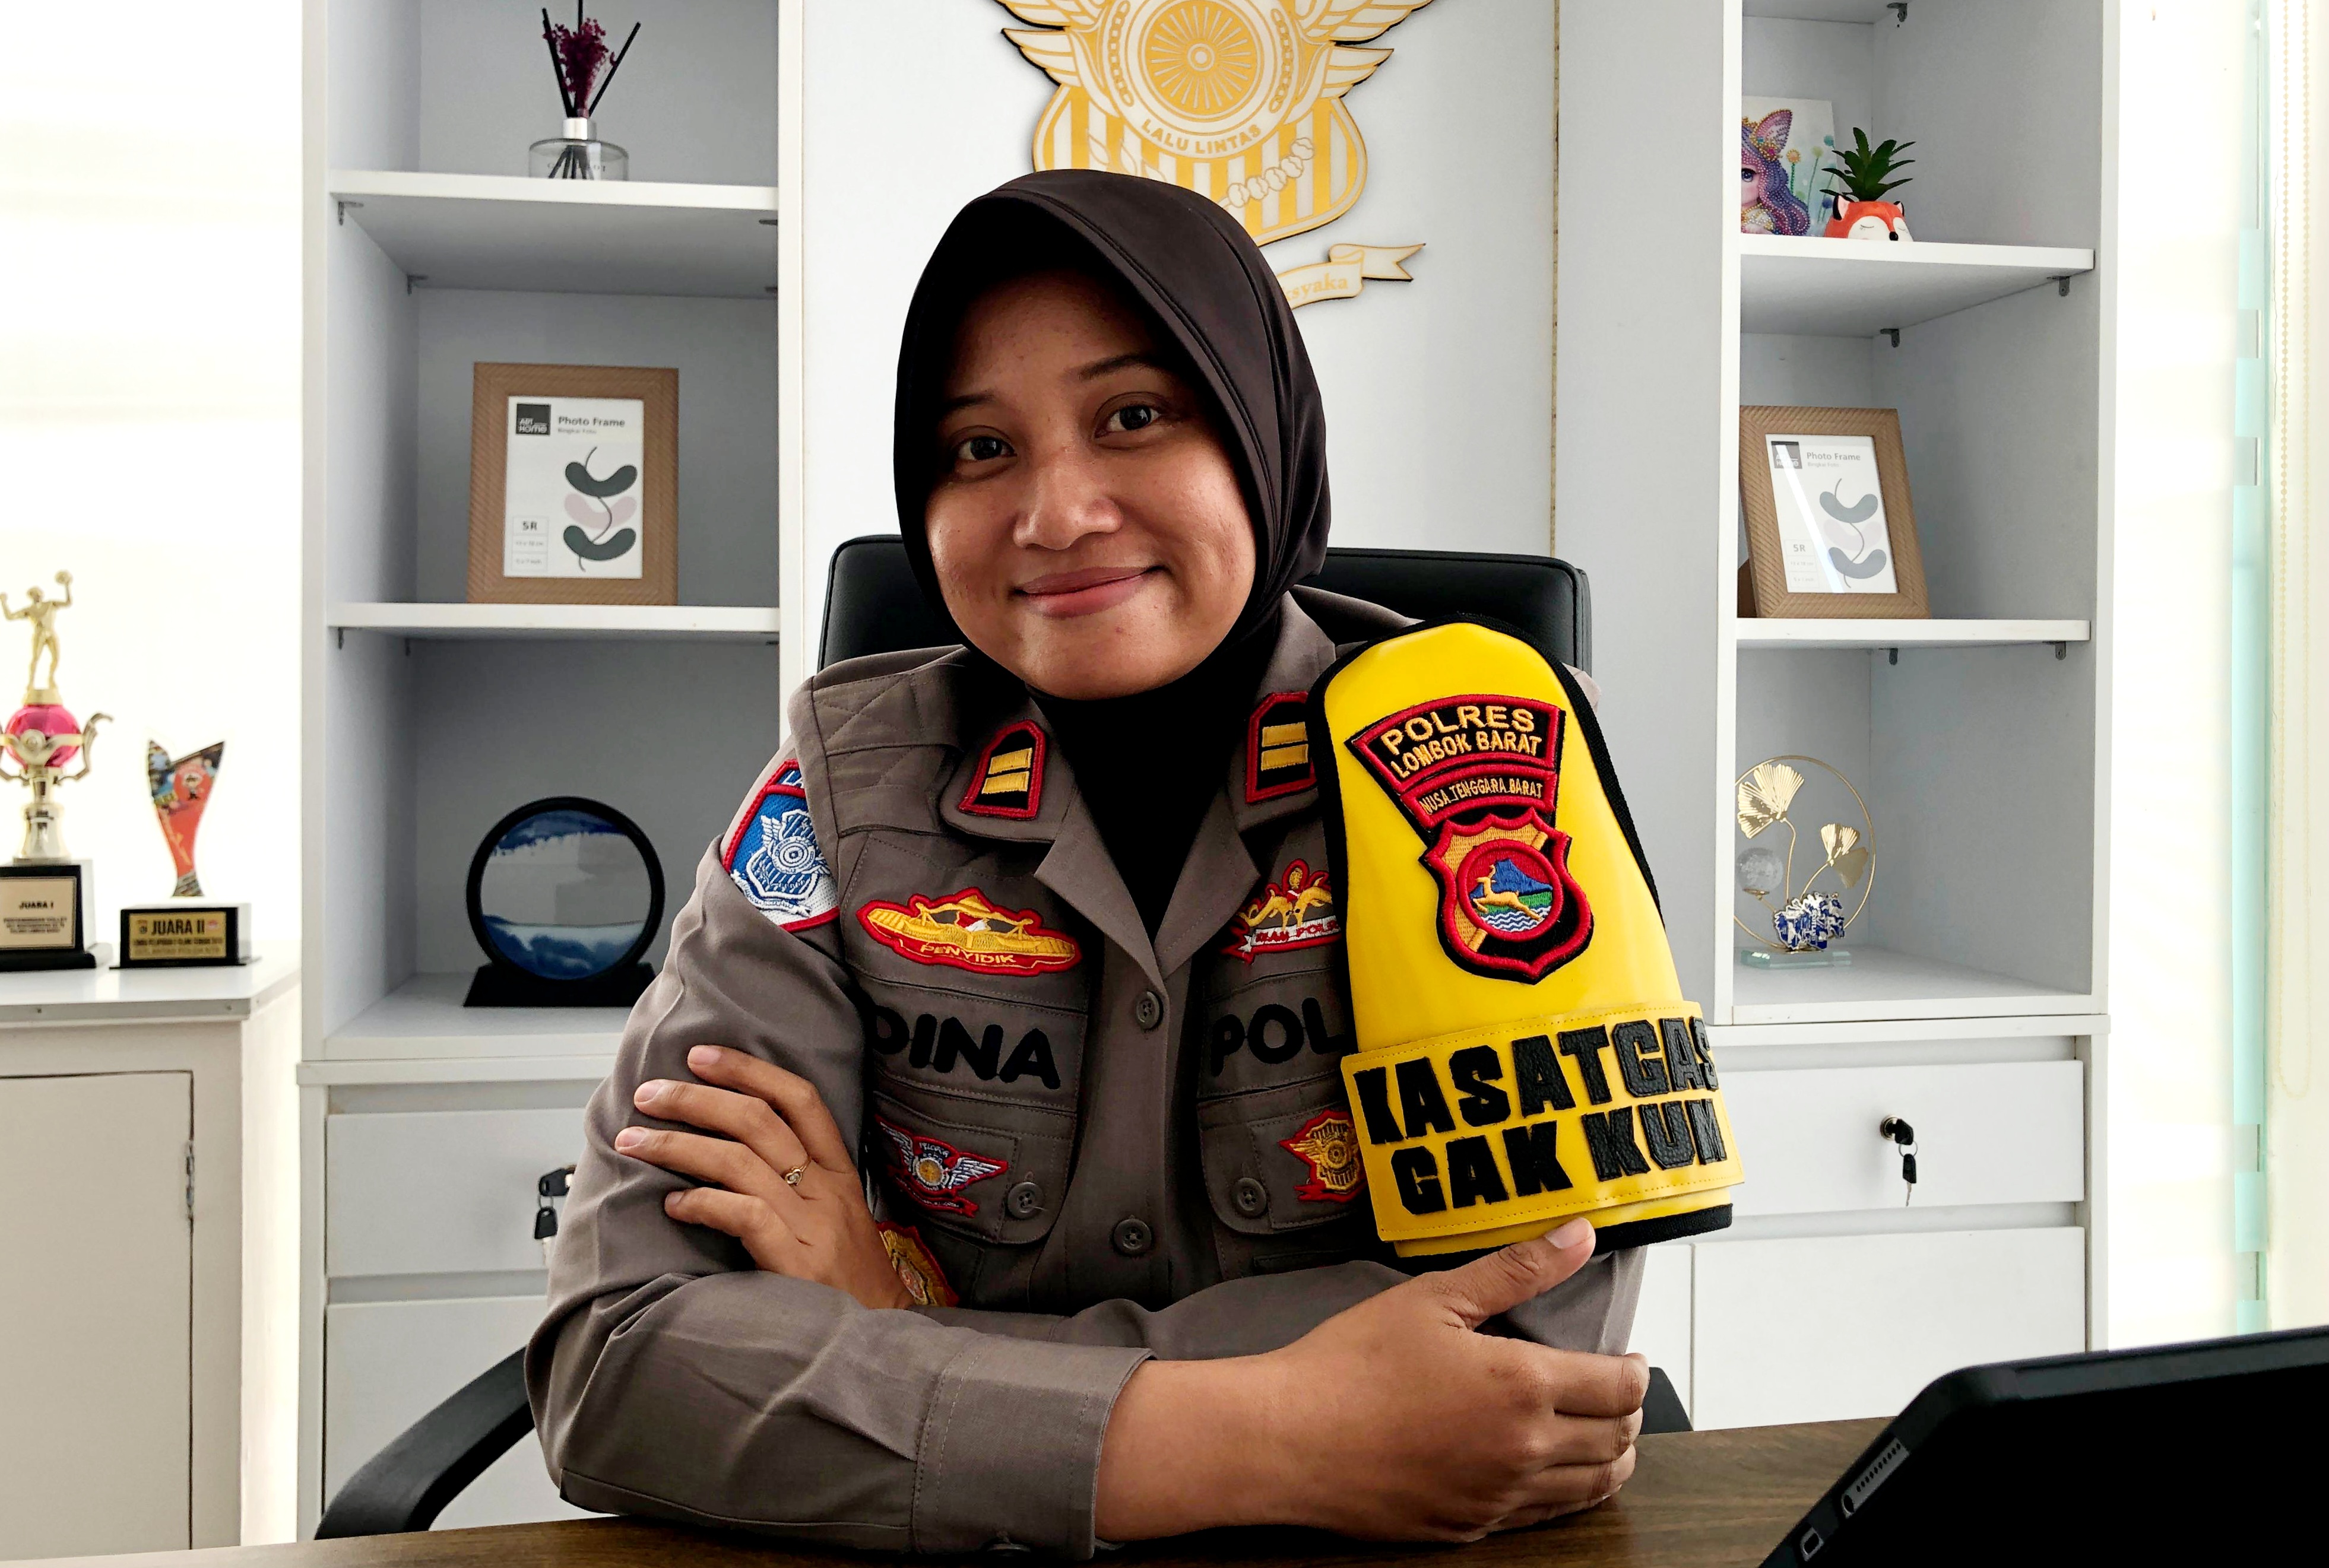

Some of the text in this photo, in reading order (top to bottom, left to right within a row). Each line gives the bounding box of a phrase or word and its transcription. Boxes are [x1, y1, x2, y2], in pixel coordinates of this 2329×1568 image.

[1142, 119, 1261, 154] LALU LINTAS
[559, 417, 626, 427] Photo Frame
[523, 521, 537, 531] 5R
[1381, 705, 1534, 755] POLRES
[1391, 730, 1542, 778] LOMBOK BARAT
[1419, 778, 1543, 815] NUSA TENGGARA BARAT
[151, 919, 205, 935] JUARA II
[920, 942, 1016, 963] PENYIDIK
[869, 1005, 1061, 1090] DINA
[1353, 1015, 1718, 1145] KASATGAS
[1391, 1099, 1727, 1215] GAK KUM
